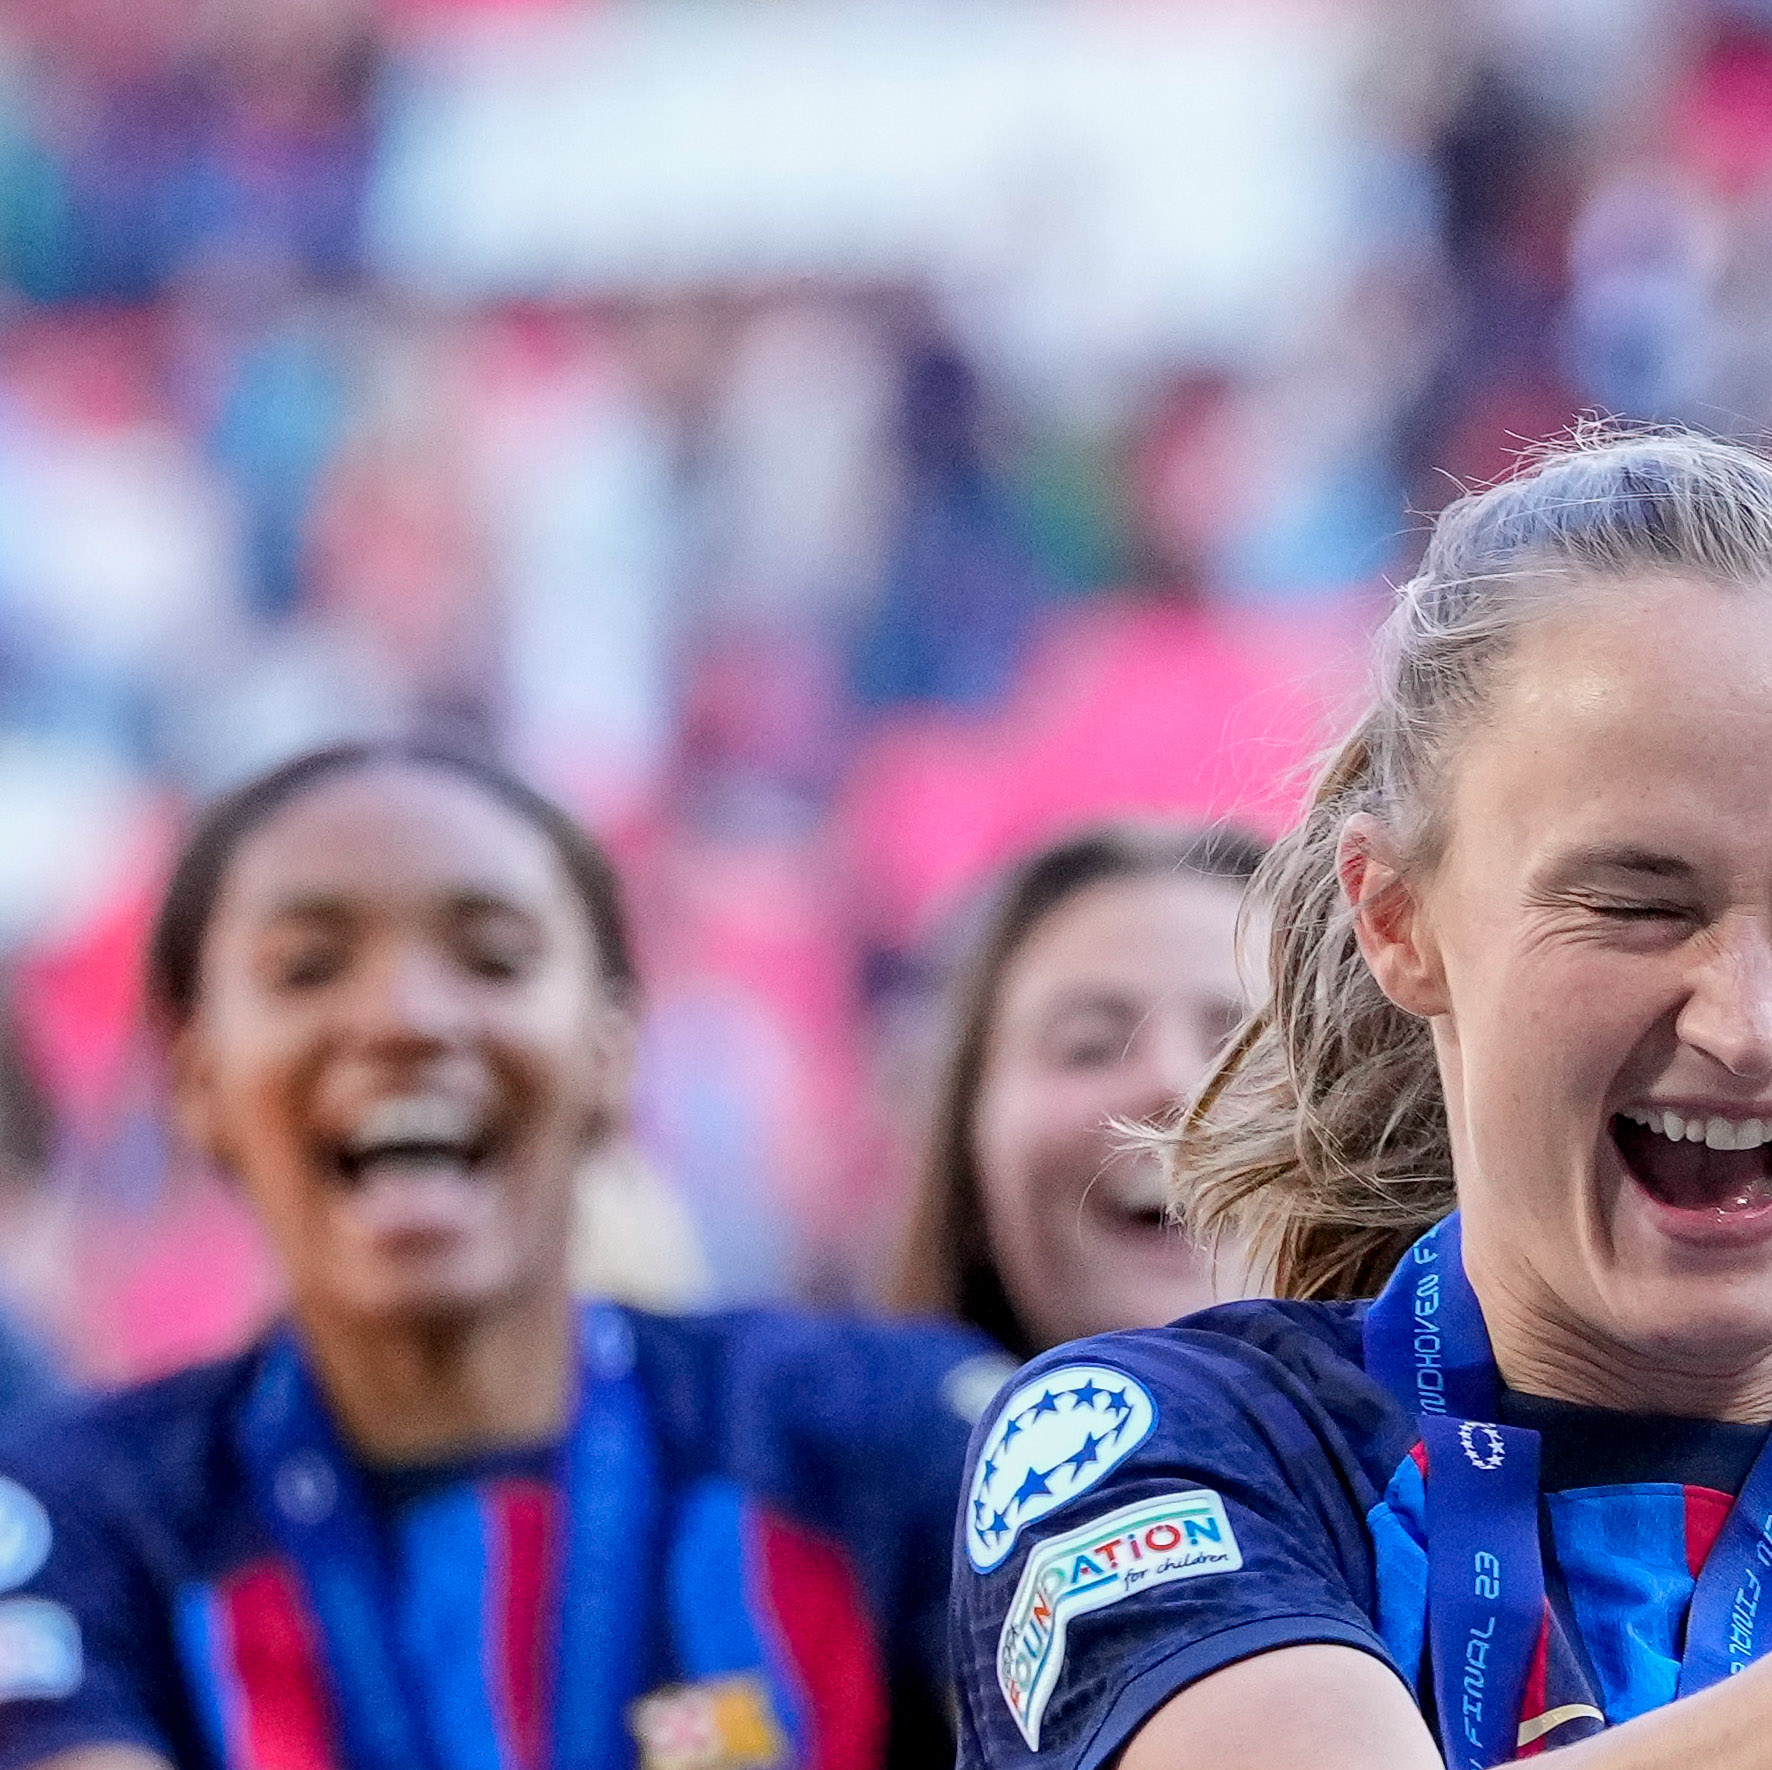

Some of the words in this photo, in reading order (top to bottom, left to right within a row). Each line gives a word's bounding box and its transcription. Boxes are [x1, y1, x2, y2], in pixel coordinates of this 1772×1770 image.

[1414, 1273, 1447, 1416] NDHOVEN
[1124, 1567, 1148, 1592] for
[1156, 1551, 1229, 1574] children
[1474, 1550, 1500, 1600] 23
[1729, 1568, 1760, 1656] FINAL
[1464, 1615, 1495, 1749] FINAL
